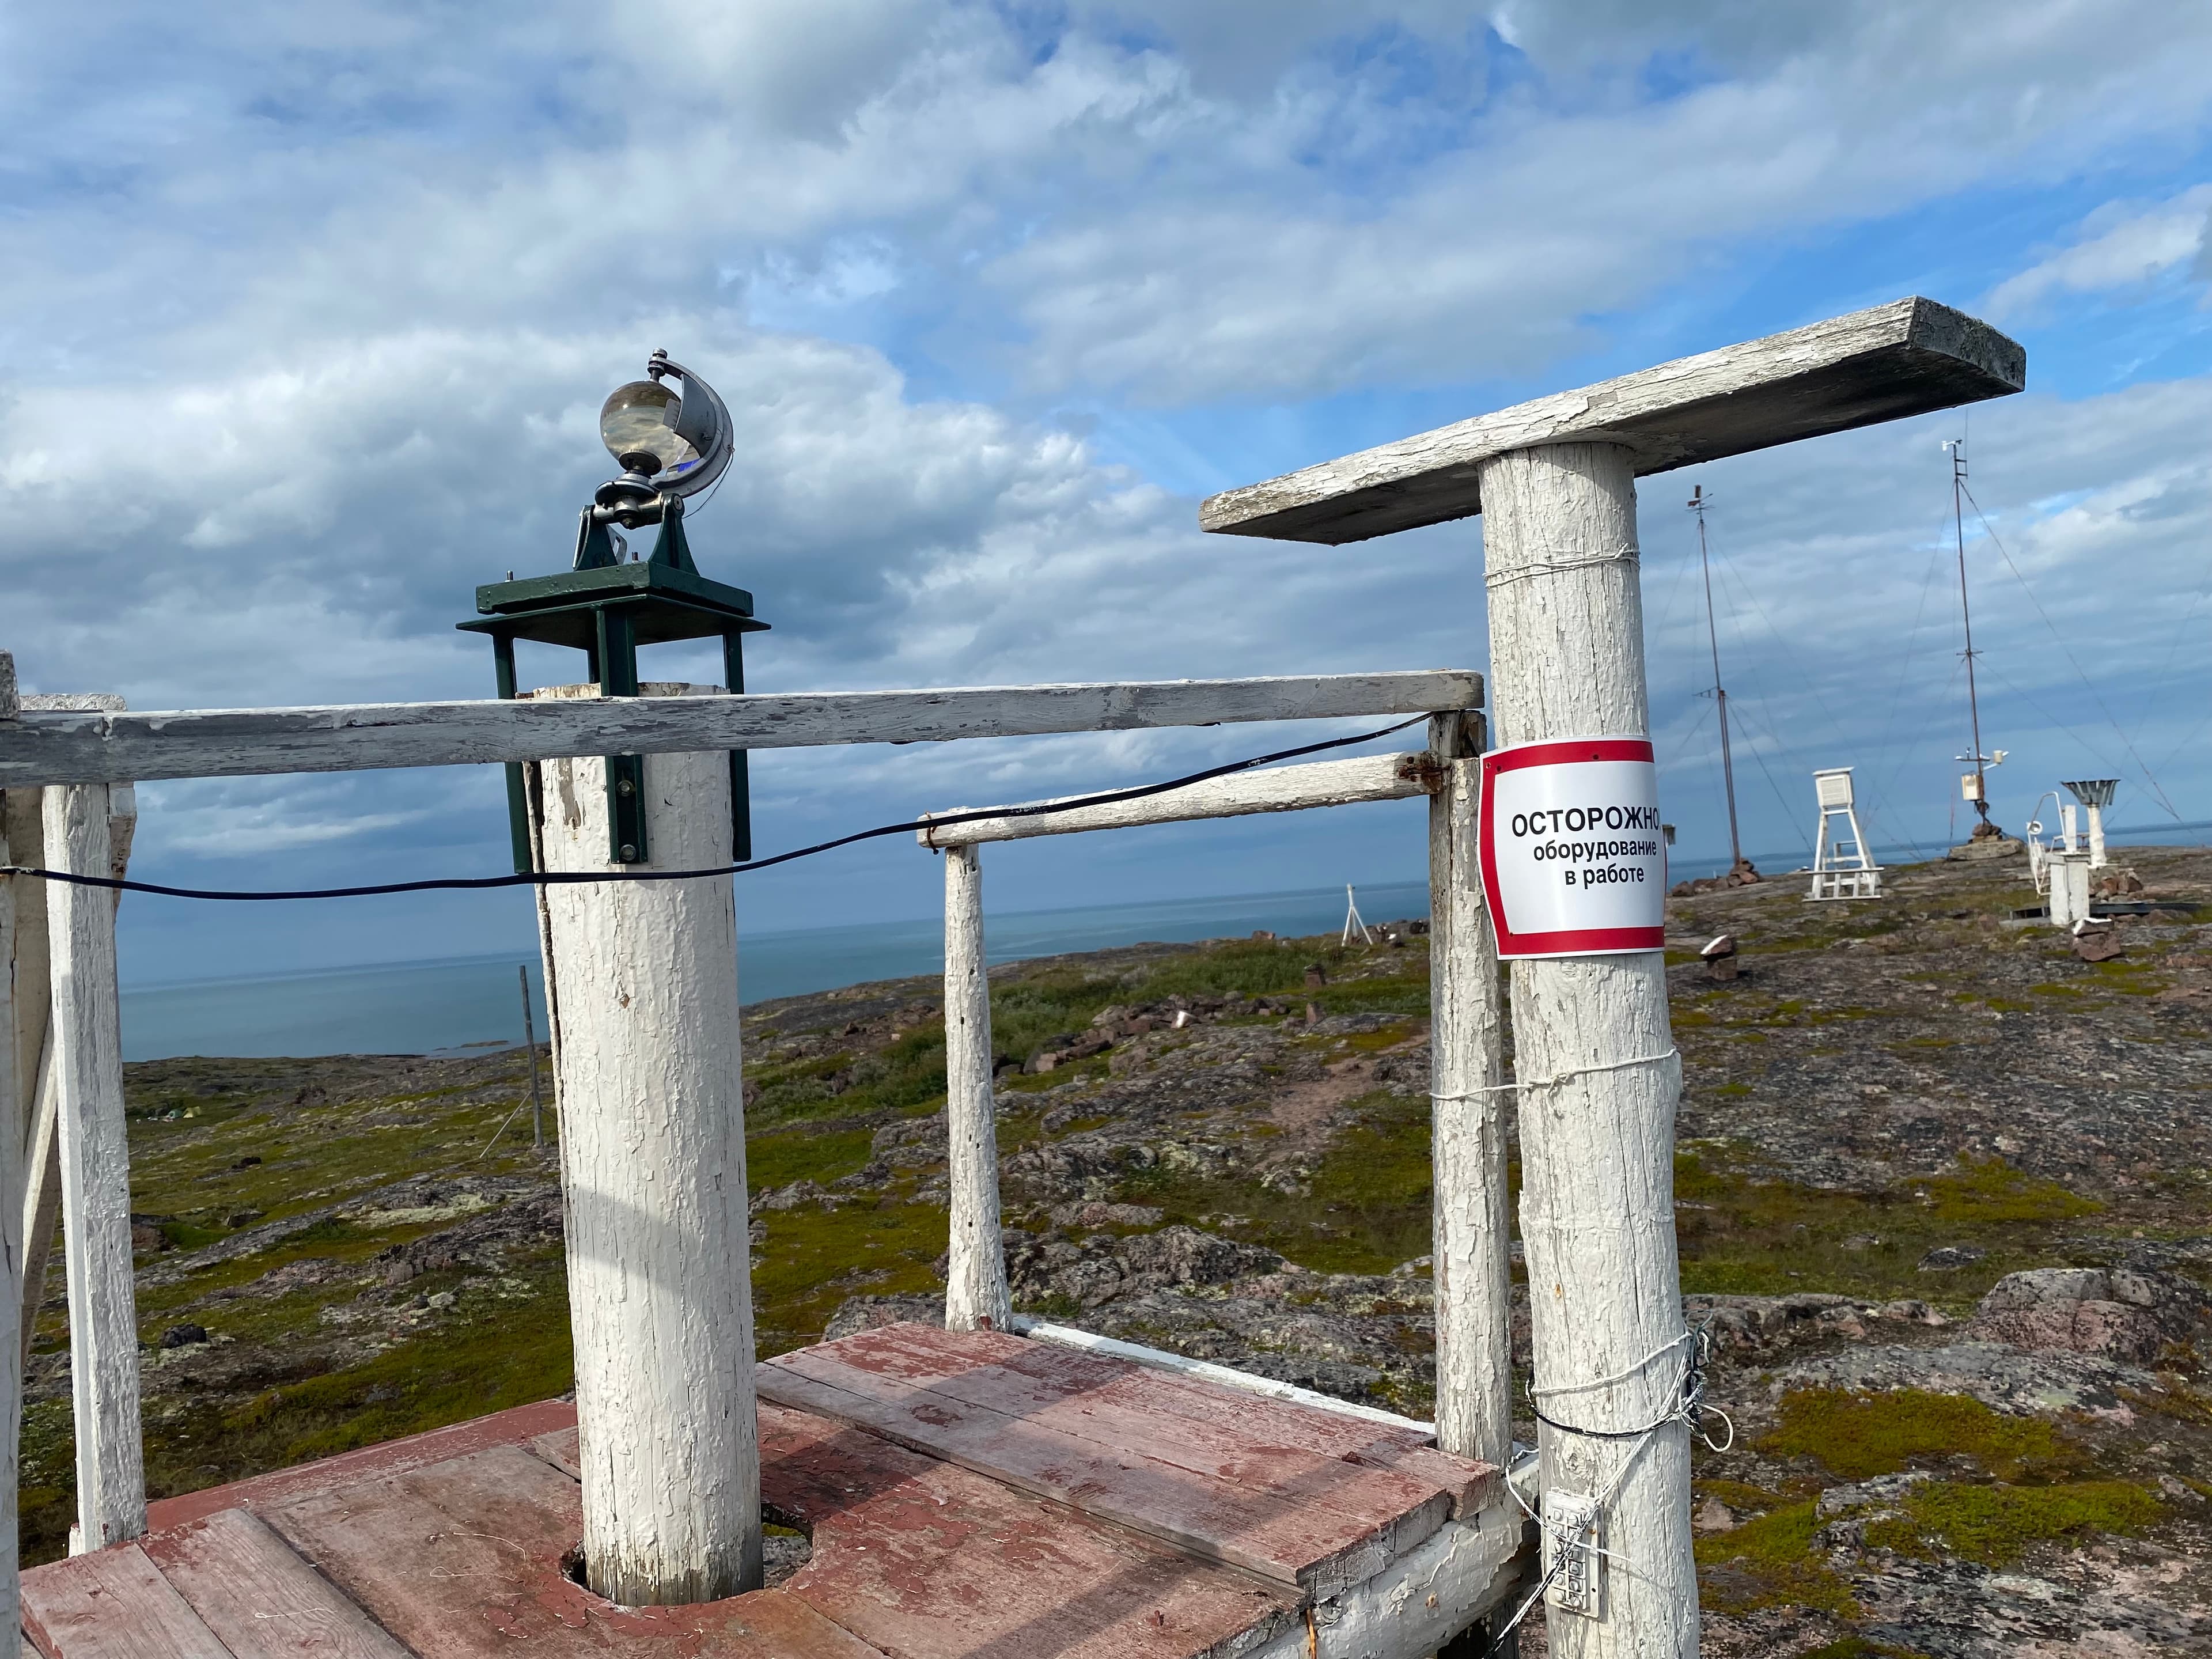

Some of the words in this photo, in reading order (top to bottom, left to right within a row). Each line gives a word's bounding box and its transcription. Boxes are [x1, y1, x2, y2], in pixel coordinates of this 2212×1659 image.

[1533, 840, 1657, 863] оборудование
[1565, 870, 1577, 885] в
[1582, 862, 1645, 889] работе
